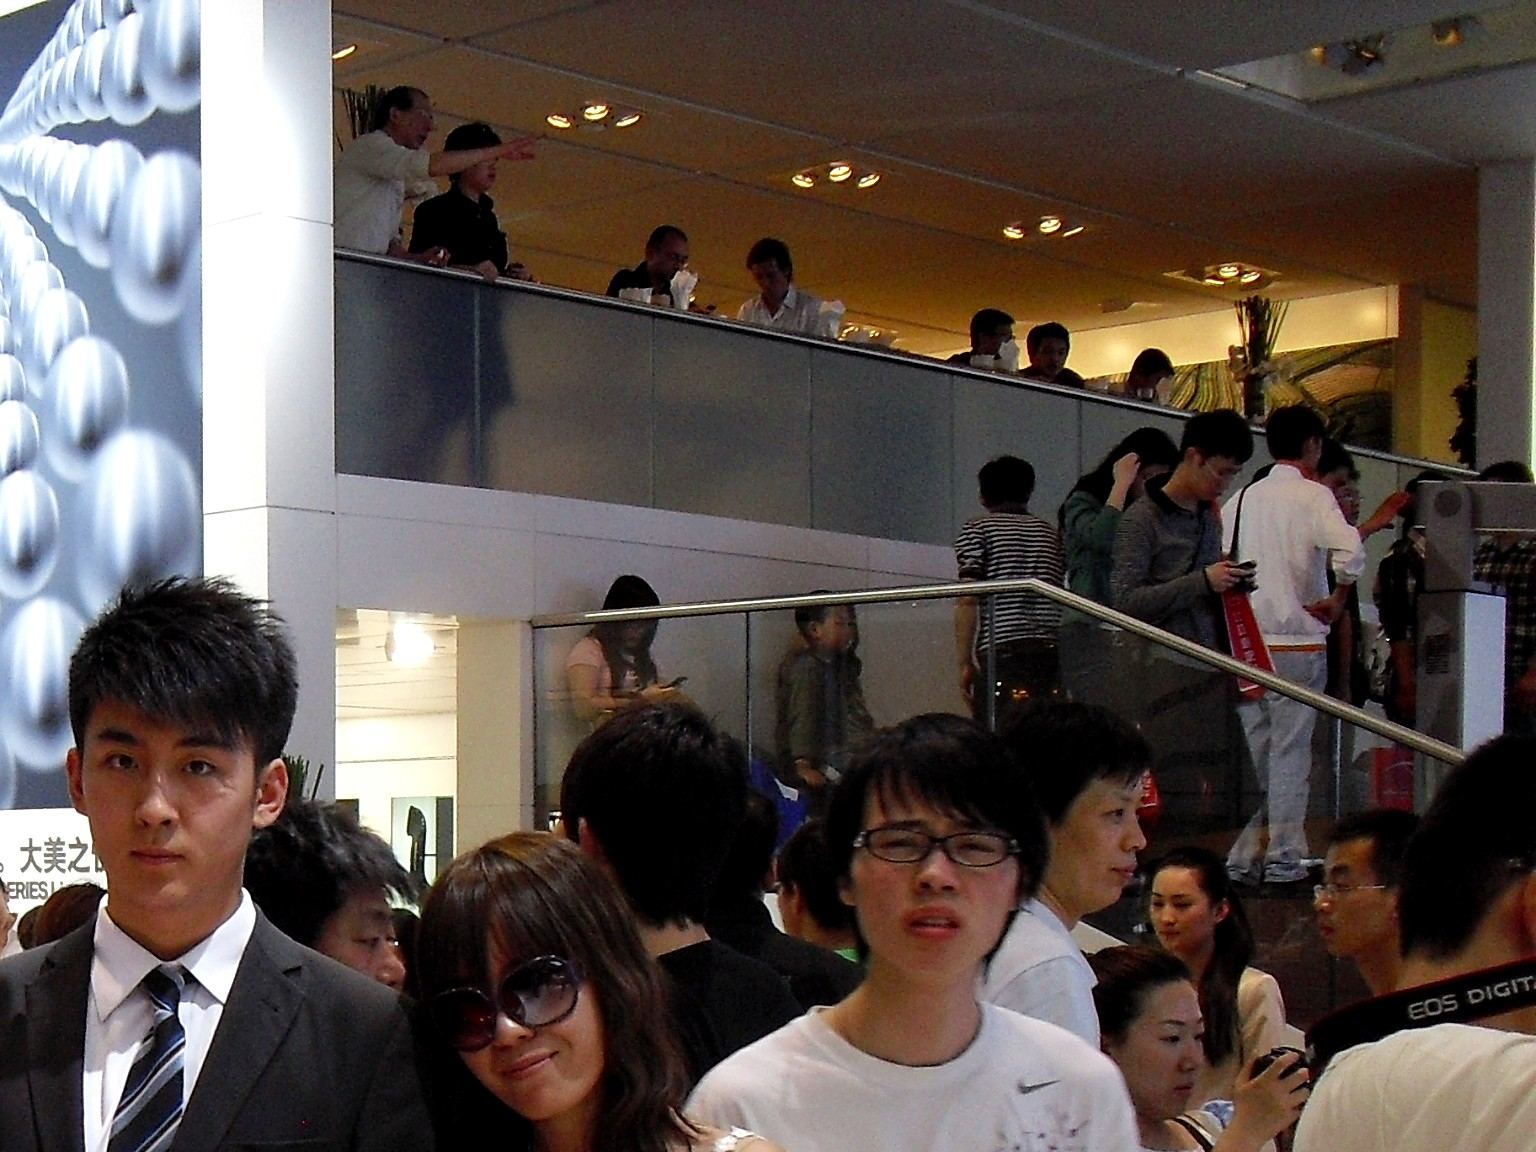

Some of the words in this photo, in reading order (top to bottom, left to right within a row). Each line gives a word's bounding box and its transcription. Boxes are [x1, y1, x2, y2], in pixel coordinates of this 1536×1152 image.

[6, 881, 49, 900] ERIES
[1408, 994, 1458, 1020] EOS
[1467, 975, 1536, 1004] DIGIT
